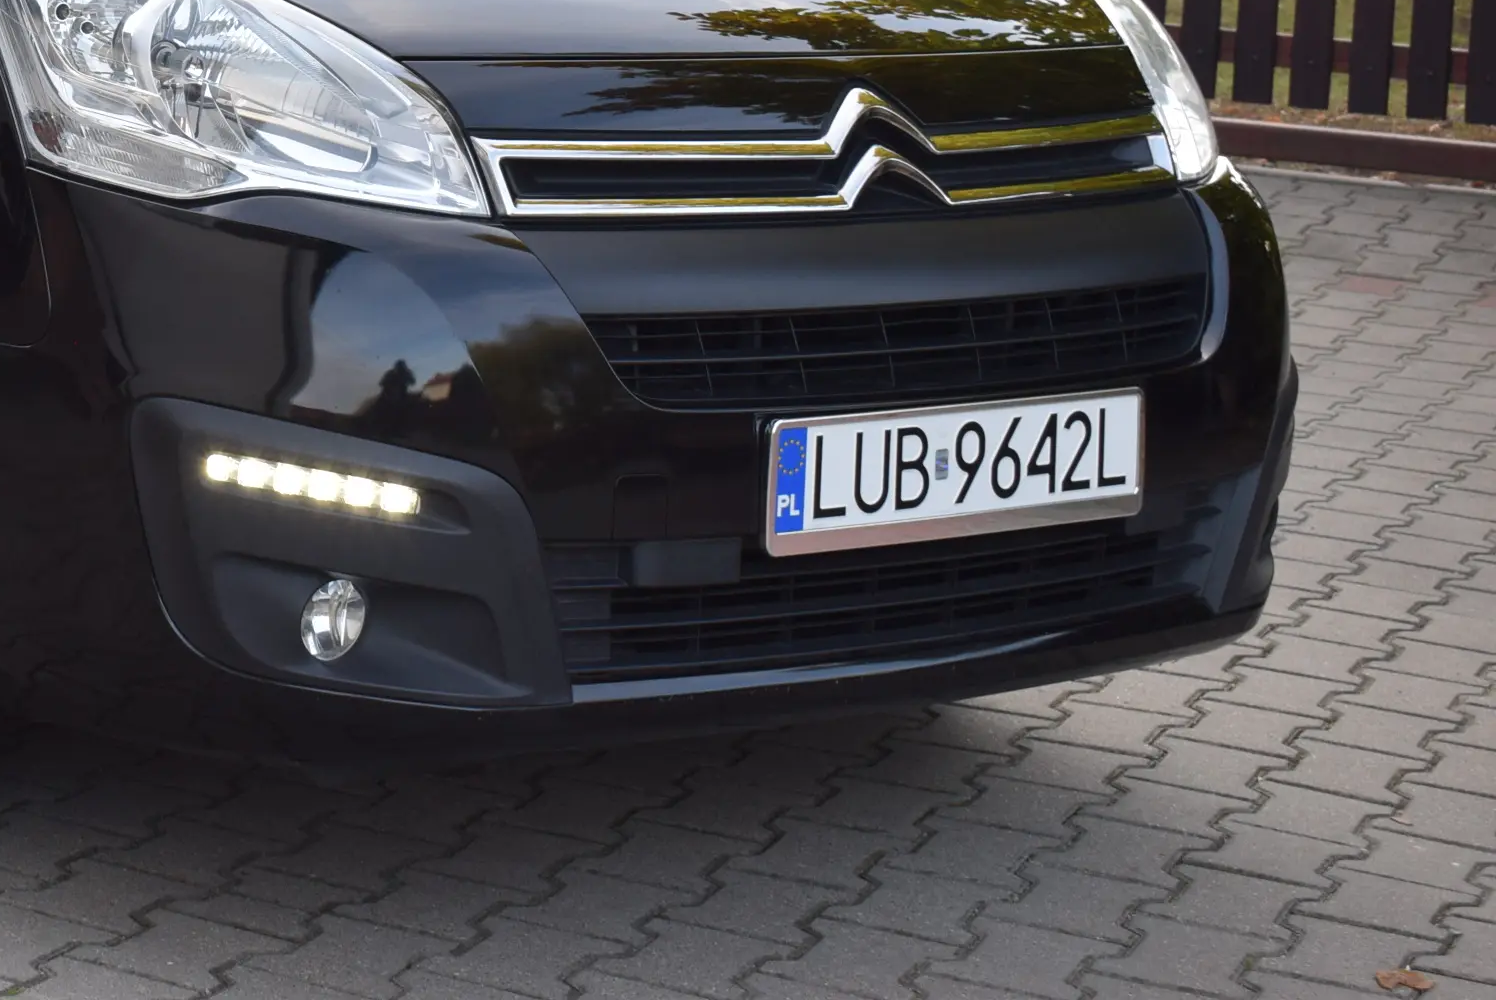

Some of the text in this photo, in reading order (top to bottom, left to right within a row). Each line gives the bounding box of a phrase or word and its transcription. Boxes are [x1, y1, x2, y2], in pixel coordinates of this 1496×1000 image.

[813, 407, 1126, 518] LUB 9642L
[776, 494, 801, 518] PL
